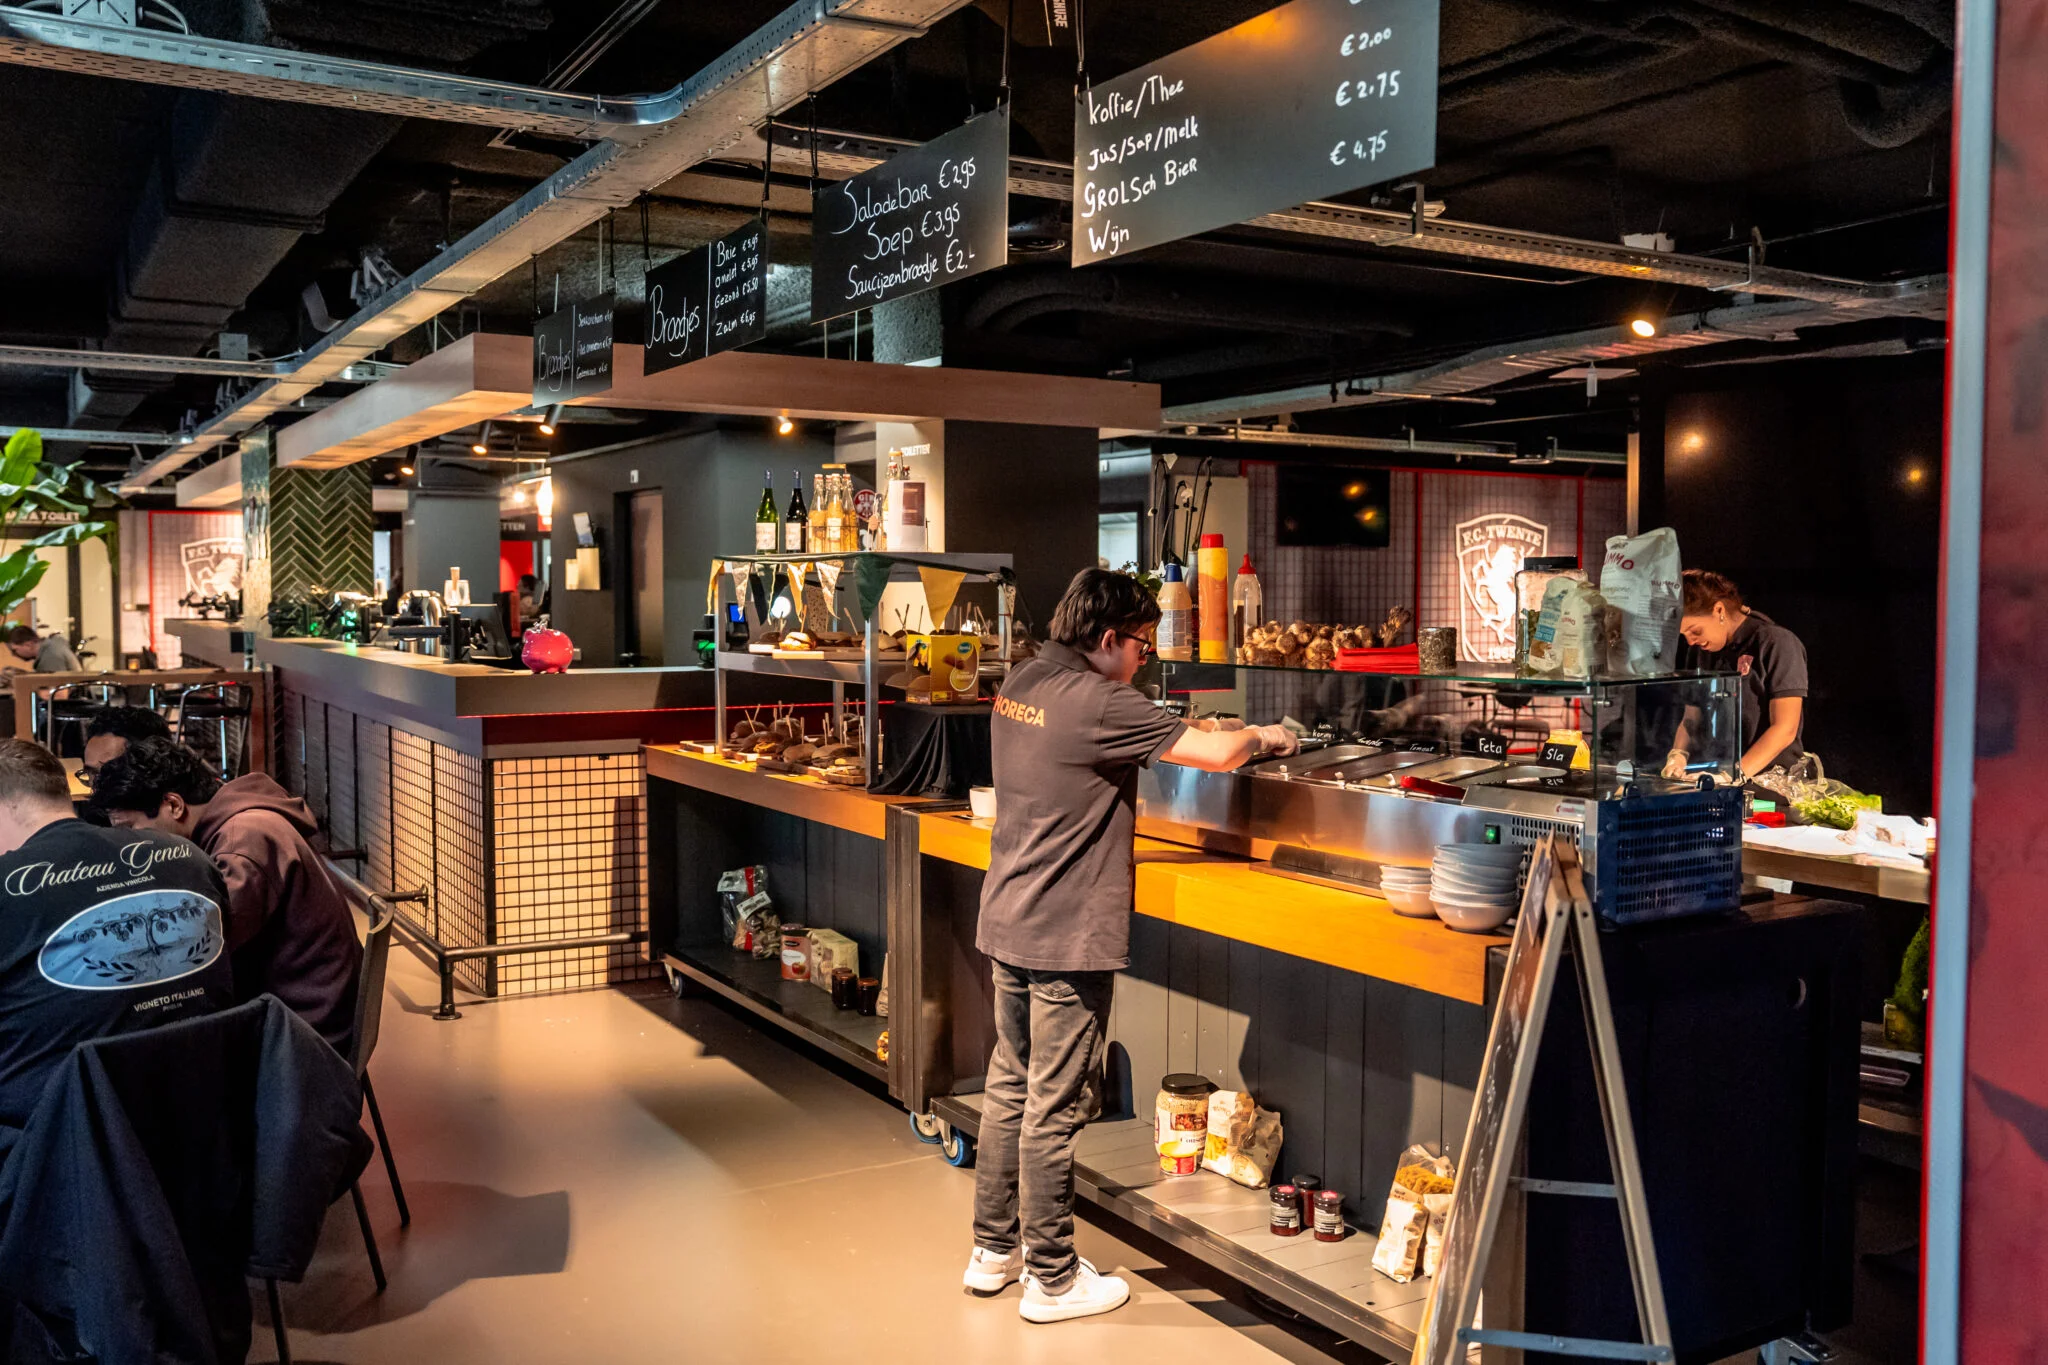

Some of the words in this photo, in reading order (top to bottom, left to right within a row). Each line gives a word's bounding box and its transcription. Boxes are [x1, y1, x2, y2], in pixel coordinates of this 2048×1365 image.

[863, 222, 914, 261] Soep
[646, 284, 700, 358] Broodjes
[1485, 525, 1543, 547] TWENTE
[993, 694, 1046, 727] HORECA
[1479, 737, 1503, 754] Feta
[1546, 748, 1564, 761] Sla
[5, 861, 117, 896] Chateau
[120, 840, 192, 877] Genesi
[96, 882, 126, 893] AZIENDA
[125, 874, 156, 887] VINICOLA
[133, 995, 171, 1012] VIGNETO
[171, 986, 205, 1002] ITALIANO
